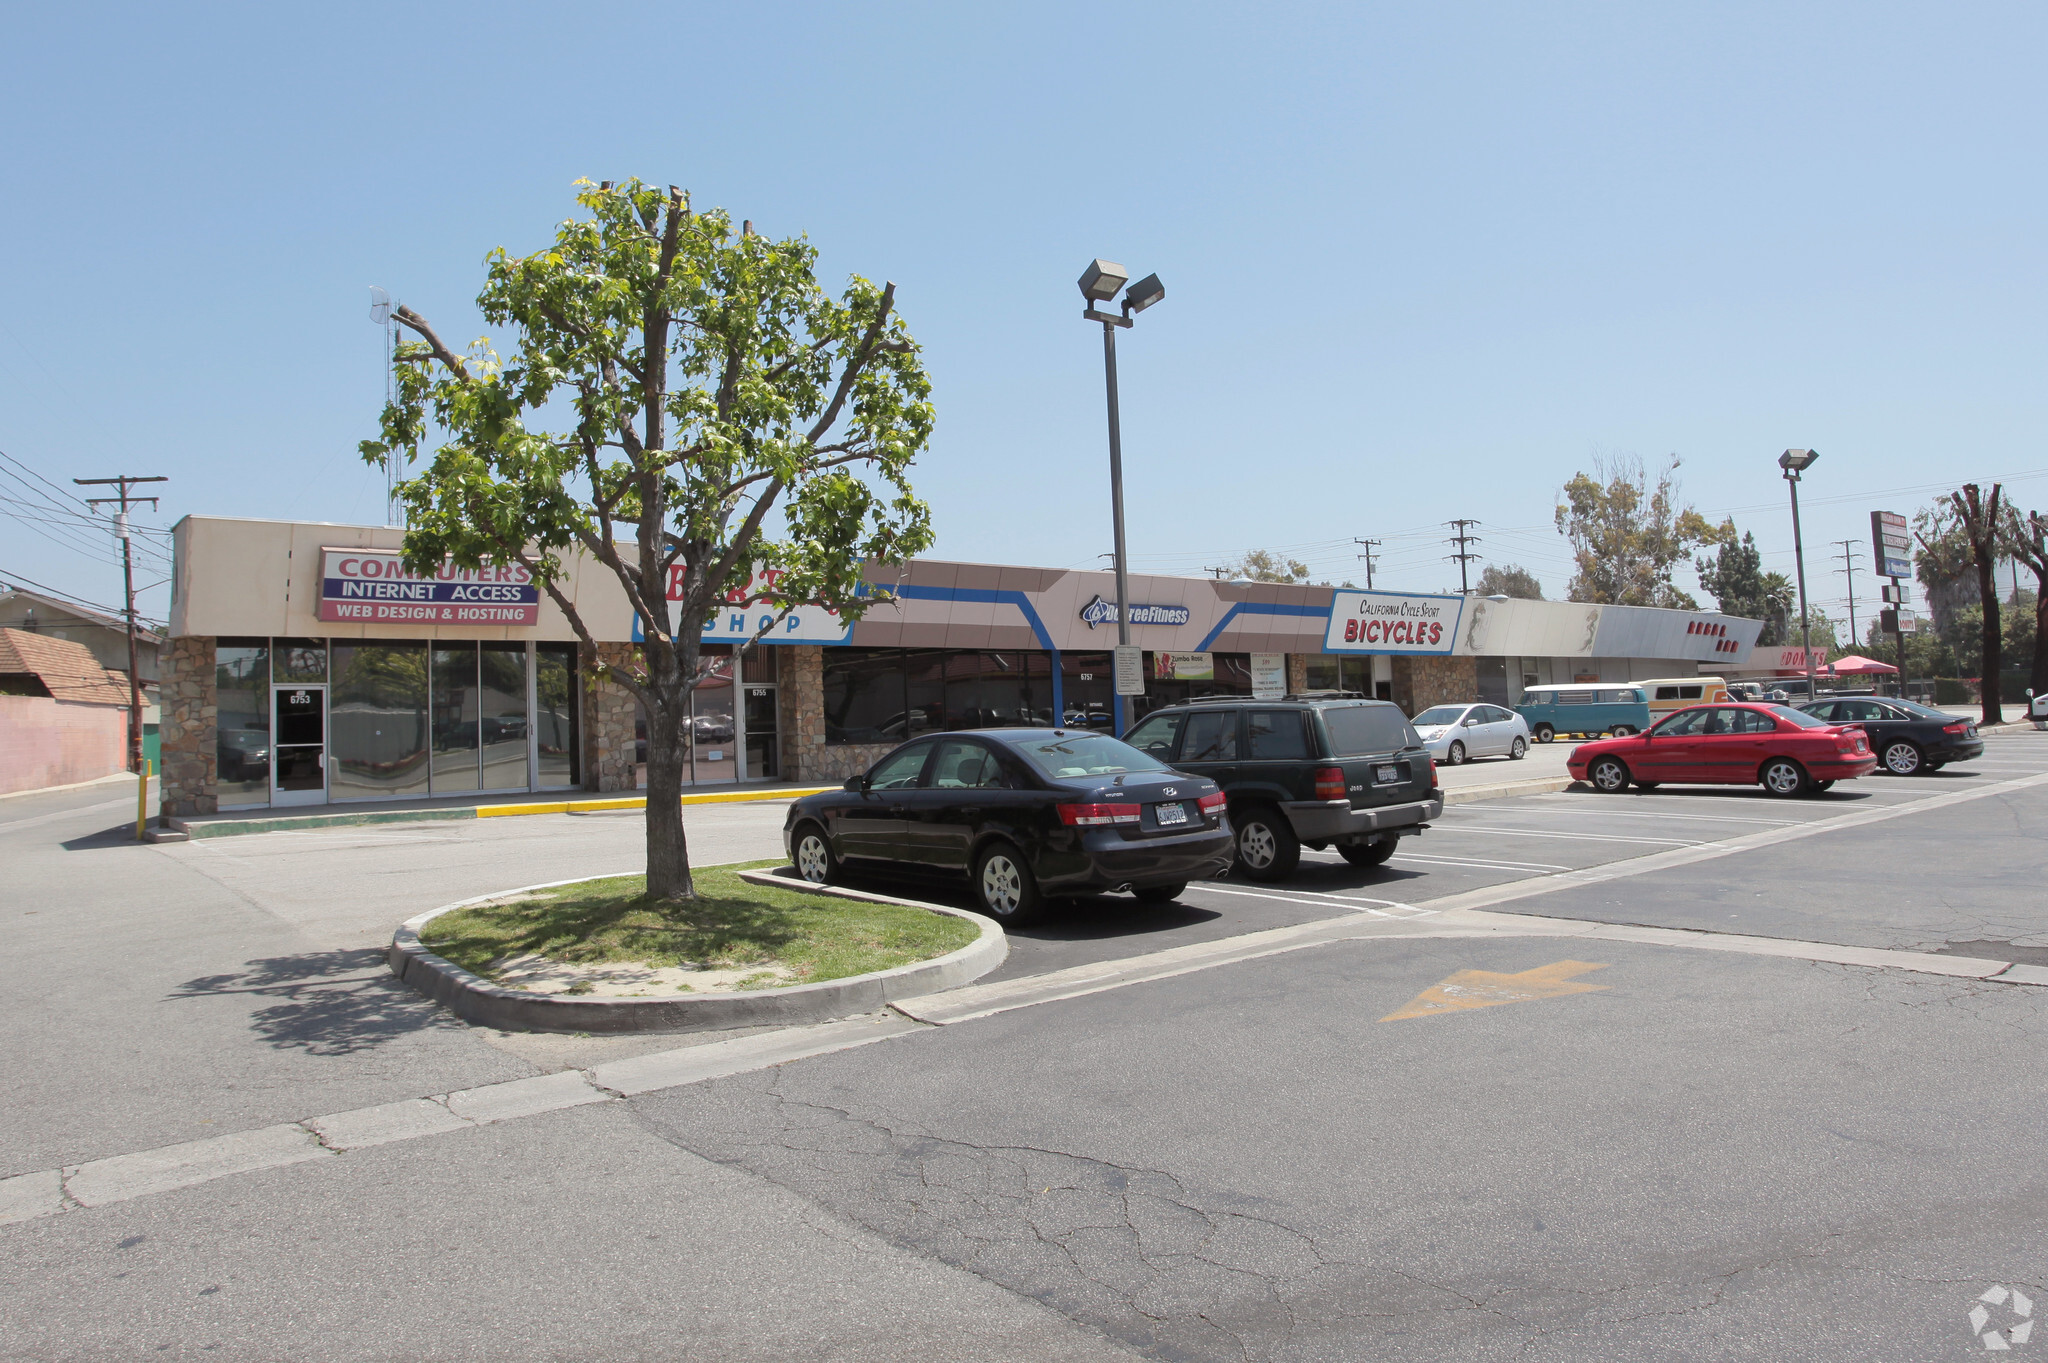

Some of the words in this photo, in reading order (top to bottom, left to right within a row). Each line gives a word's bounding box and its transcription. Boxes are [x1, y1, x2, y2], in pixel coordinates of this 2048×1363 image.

[338, 558, 530, 583] COMUTERS
[342, 581, 436, 599] INTERNET
[451, 586, 522, 601] ACCESS
[336, 604, 373, 618] WEB
[377, 606, 437, 619] DESIGN
[441, 608, 453, 620] &
[458, 608, 525, 620] HOSTING
[1105, 604, 1188, 624] DereeFitness
[1360, 600, 1399, 616] CALIFORNIA
[1401, 601, 1420, 617] CYCLE
[1420, 602, 1440, 618] SPORT
[1344, 618, 1443, 645] BICYCLES
[1687, 621, 1727, 637] REGAL
[1785, 651, 1825, 665] DONTS
[1081, 673, 1093, 681] 6757
[290, 695, 311, 704] 6753
[752, 688, 767, 697] 6755
